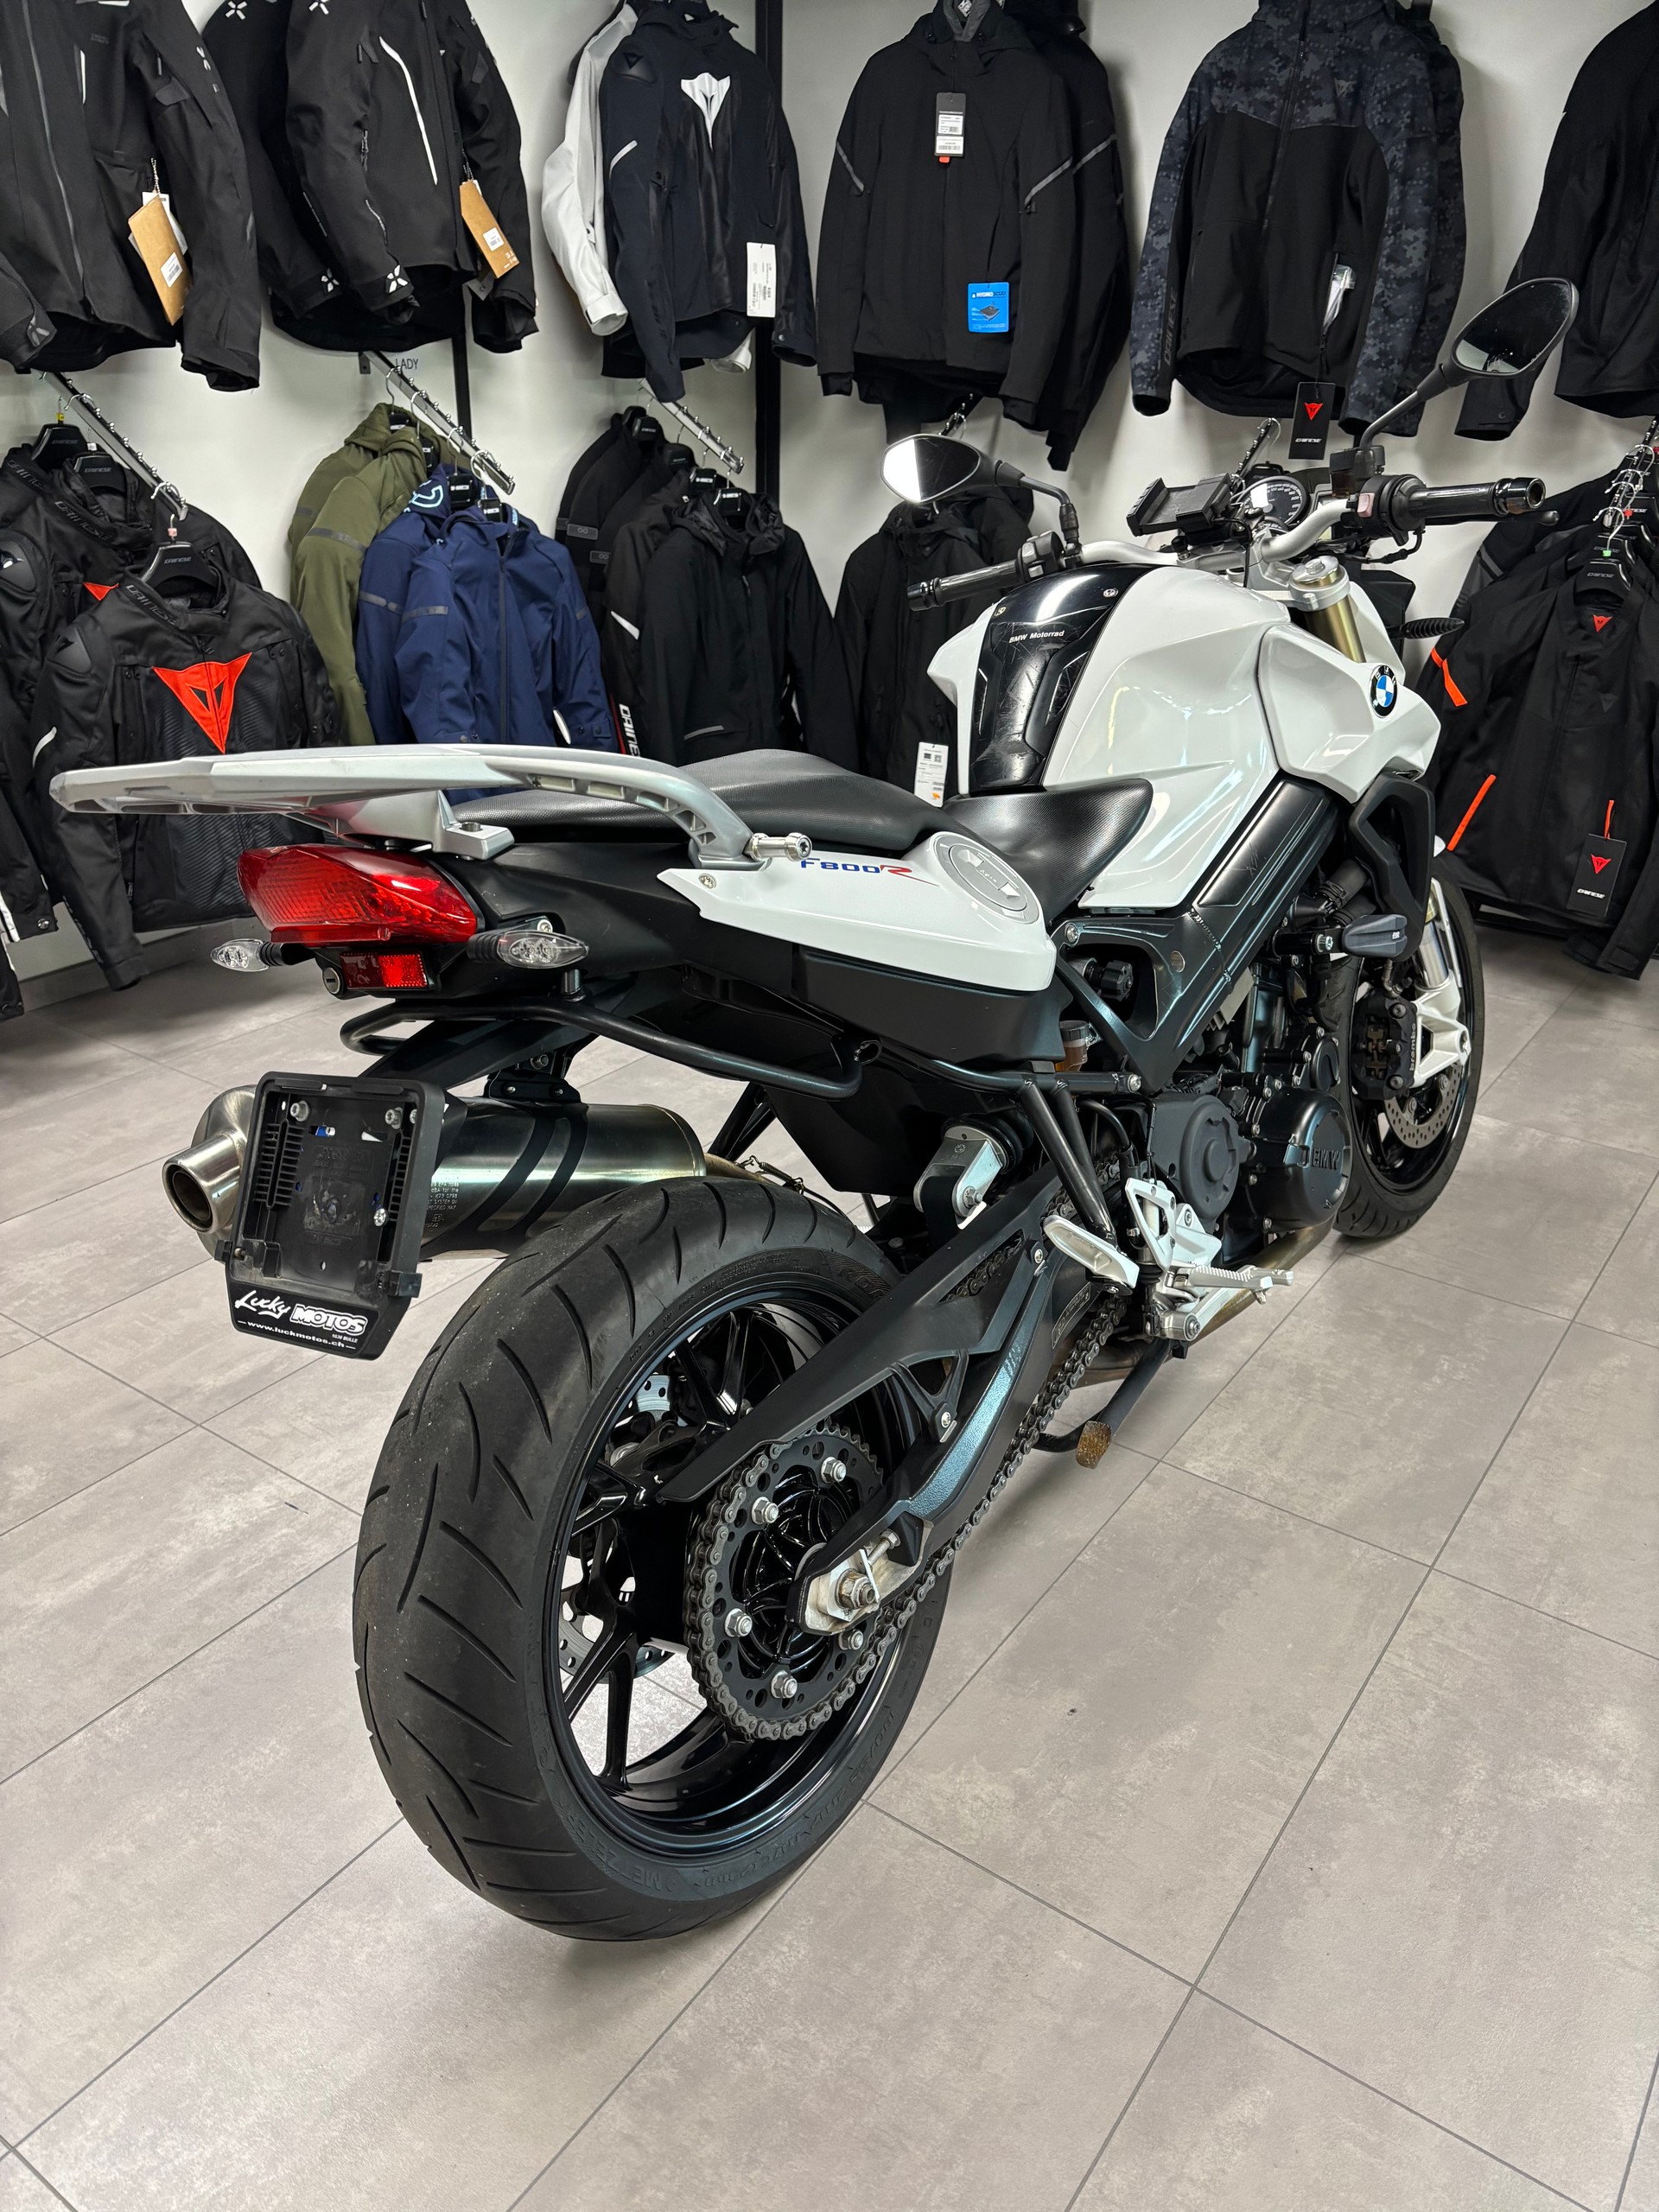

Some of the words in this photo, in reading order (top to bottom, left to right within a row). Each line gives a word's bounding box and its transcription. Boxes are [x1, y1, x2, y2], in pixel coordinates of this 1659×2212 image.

[1008, 633, 1027, 644] BMW
[1029, 630, 1065, 639] Motorrad
[1312, 1147, 1342, 1171] BMW
[234, 1290, 291, 1319] Lucky
[289, 1303, 368, 1336] MOTOS
[247, 1321, 345, 1347] www.luckmotos.ch
